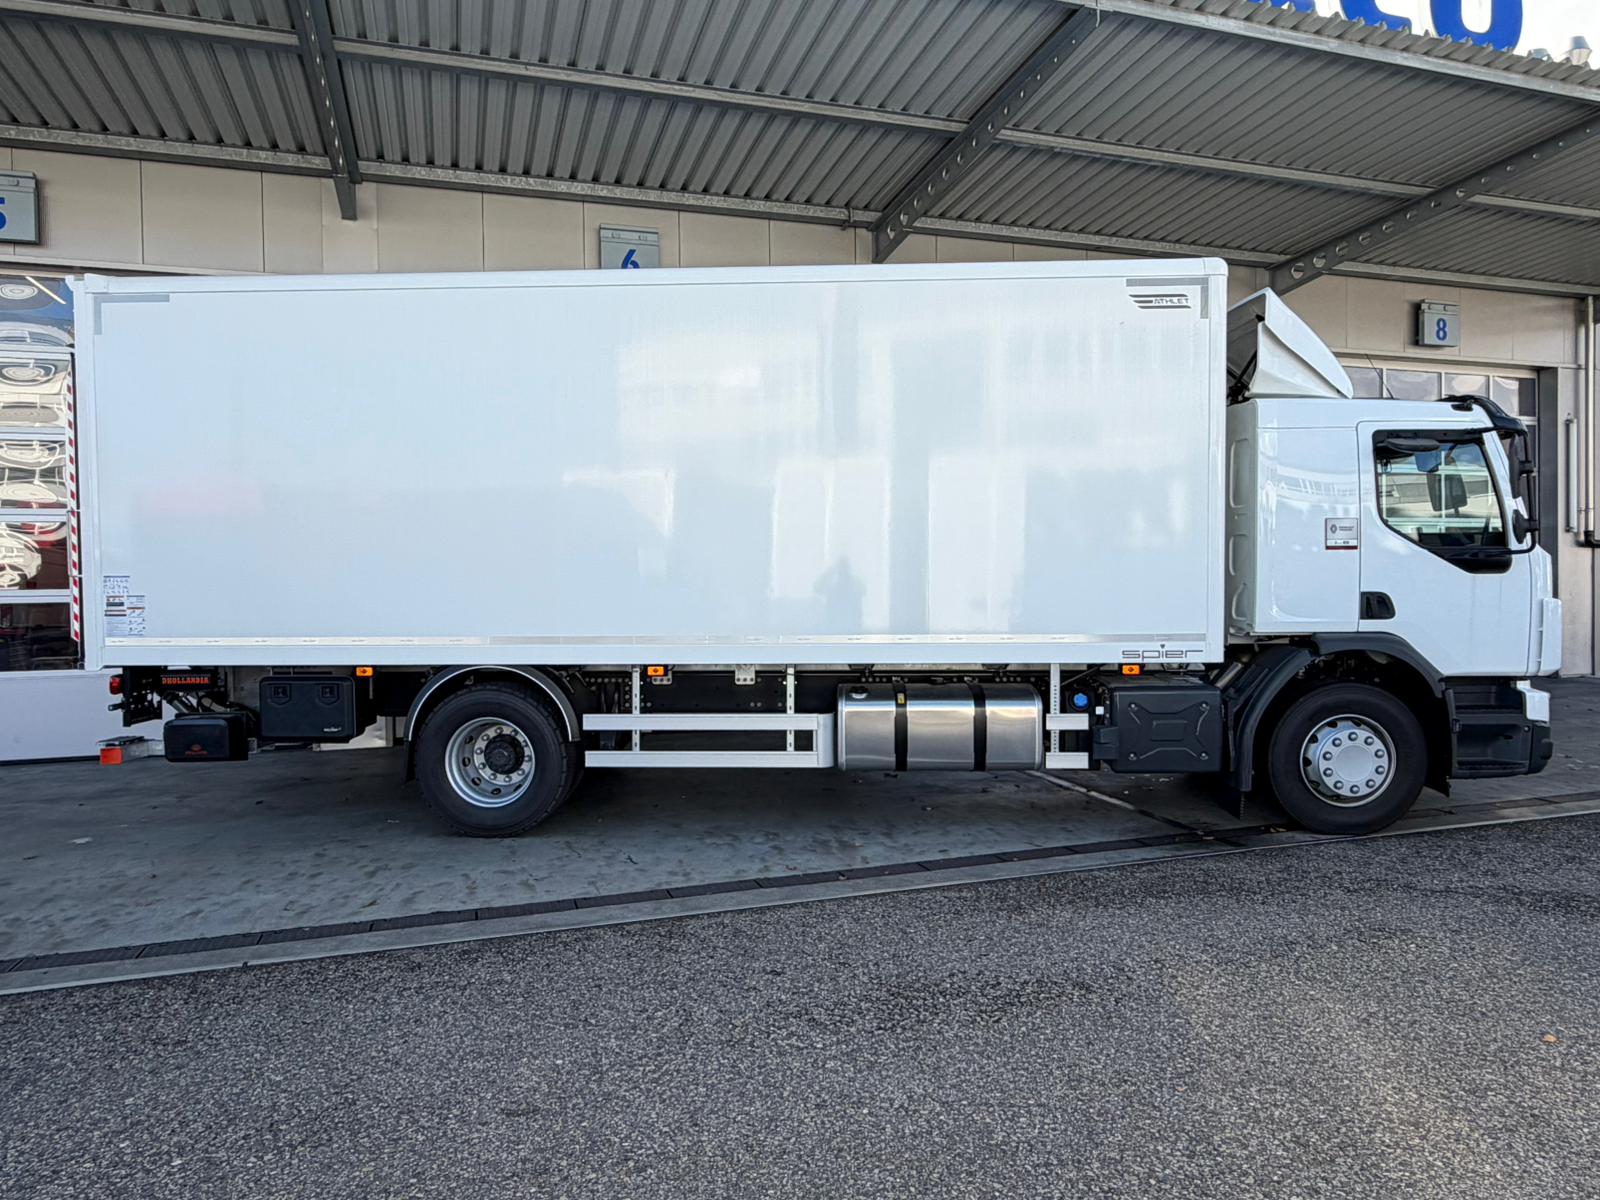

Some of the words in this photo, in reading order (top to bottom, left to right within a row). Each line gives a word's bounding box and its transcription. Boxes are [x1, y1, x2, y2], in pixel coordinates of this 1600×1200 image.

[621, 249, 640, 269] 6
[1436, 318, 1448, 341] 8
[1121, 644, 1204, 662] spier
